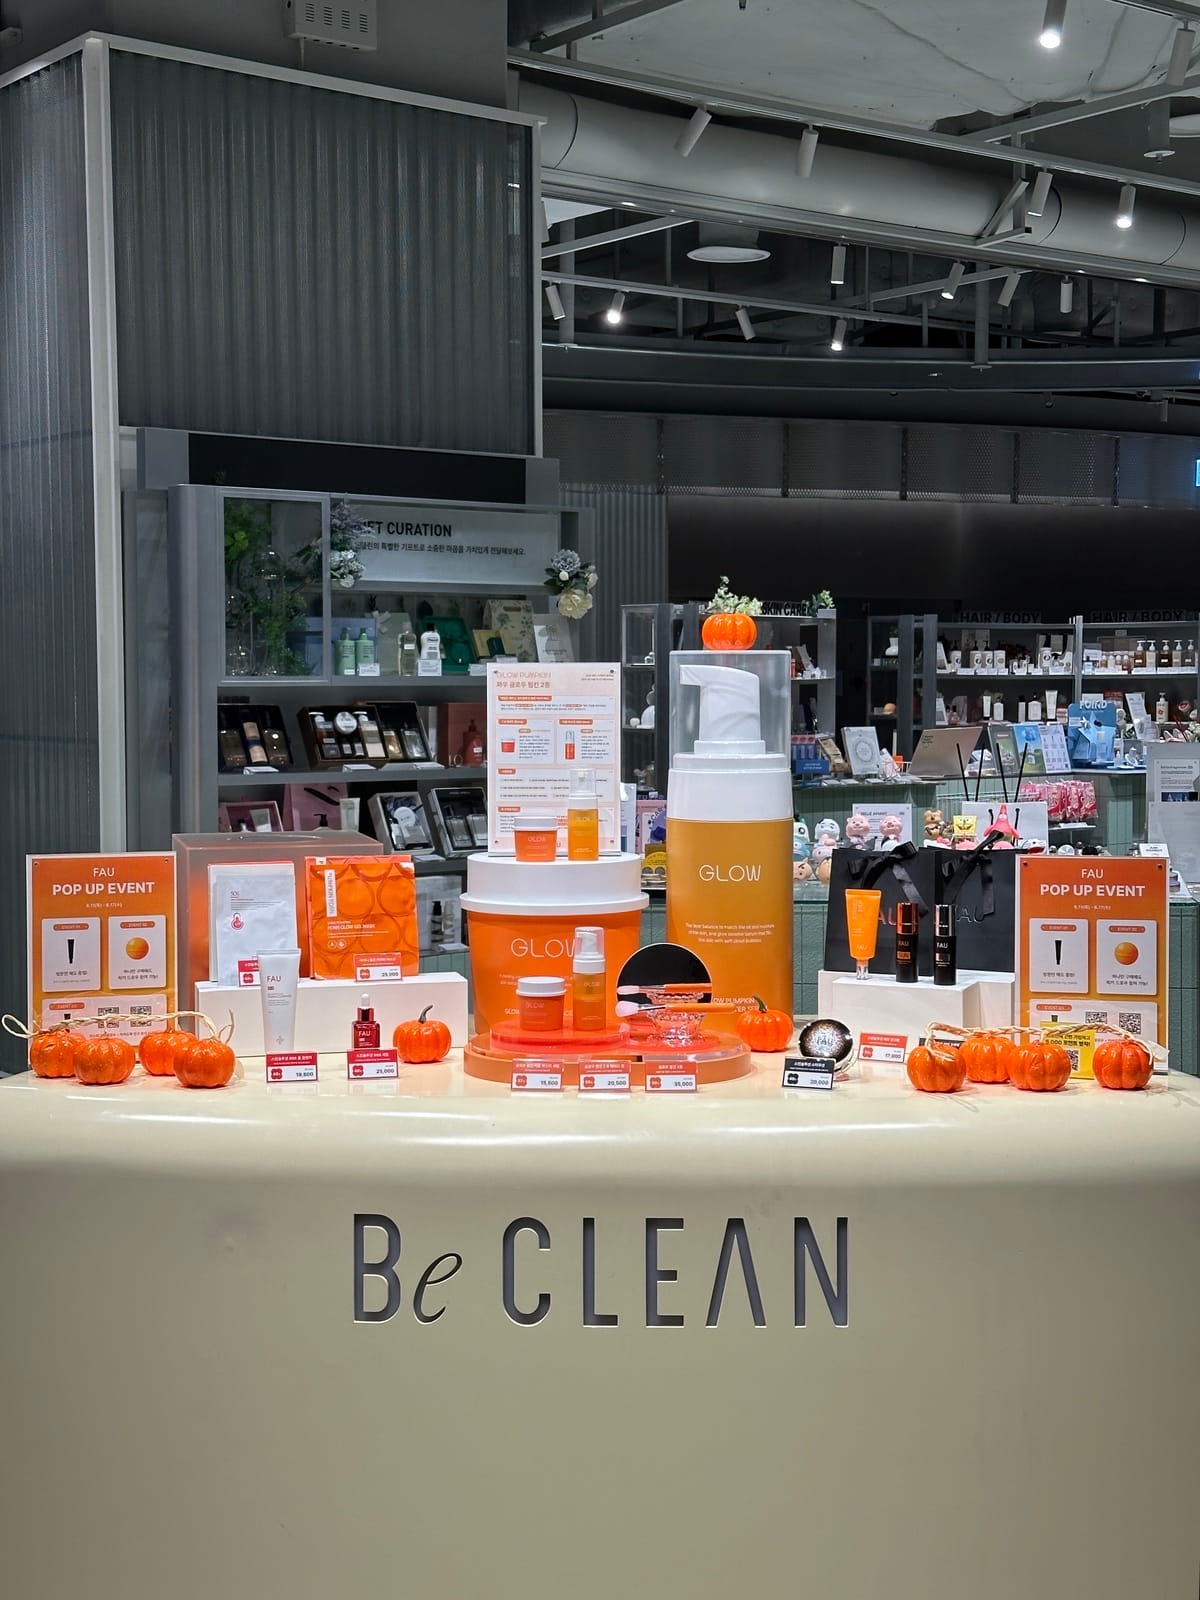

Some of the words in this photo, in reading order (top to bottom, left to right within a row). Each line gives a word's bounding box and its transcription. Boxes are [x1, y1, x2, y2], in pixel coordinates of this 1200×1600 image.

[386, 521, 452, 537] CURATION
[761, 602, 782, 615] SKIN
[784, 602, 808, 616] CARE
[961, 611, 990, 623] HAIR
[1003, 612, 1041, 624] BODY
[1092, 611, 1127, 623] HAIR
[1141, 610, 1184, 622] BODY
[93, 867, 115, 877] FAU
[699, 864, 761, 882] GLOW
[1081, 868, 1104, 879] FAU
[52, 883, 82, 895] POP
[85, 882, 105, 894] UP
[107, 881, 155, 894] EVENT
[1040, 884, 1069, 896] POP
[1073, 884, 1092, 896] UP
[1096, 885, 1146, 897] EVENT
[266, 975, 282, 983] FAU
[353, 1213, 463, 1326] Be
[502, 1216, 848, 1328] CLEAN
